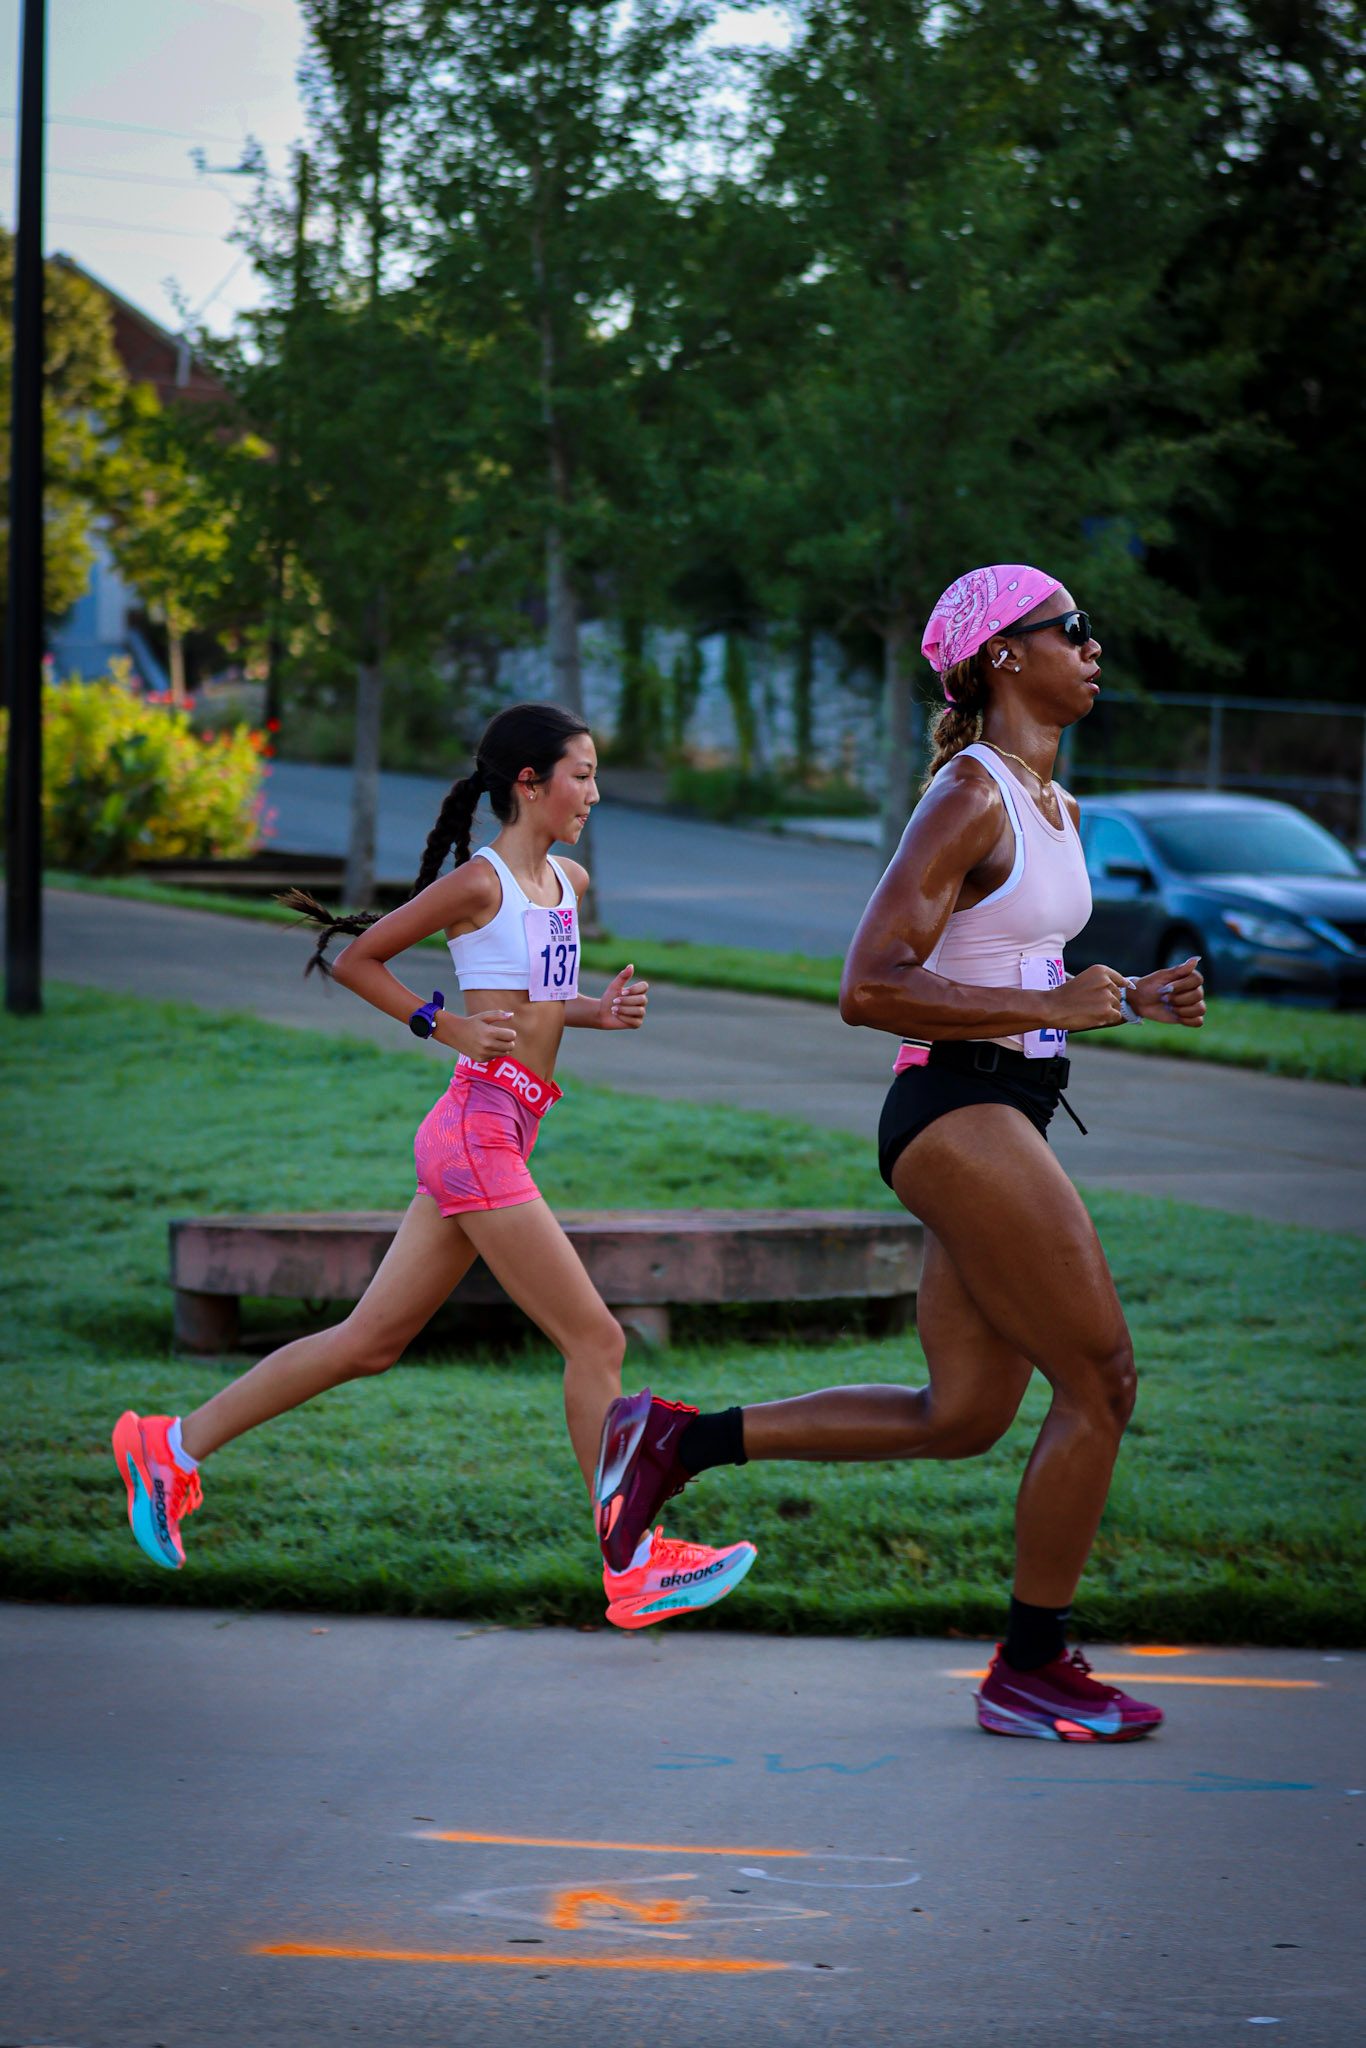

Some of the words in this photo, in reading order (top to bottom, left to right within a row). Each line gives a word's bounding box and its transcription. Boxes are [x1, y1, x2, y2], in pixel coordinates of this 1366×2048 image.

[541, 944, 577, 987] 137
[494, 1061, 542, 1103] PRO
[154, 1478, 171, 1543] BROOKS
[660, 1560, 724, 1588] BROOKS
